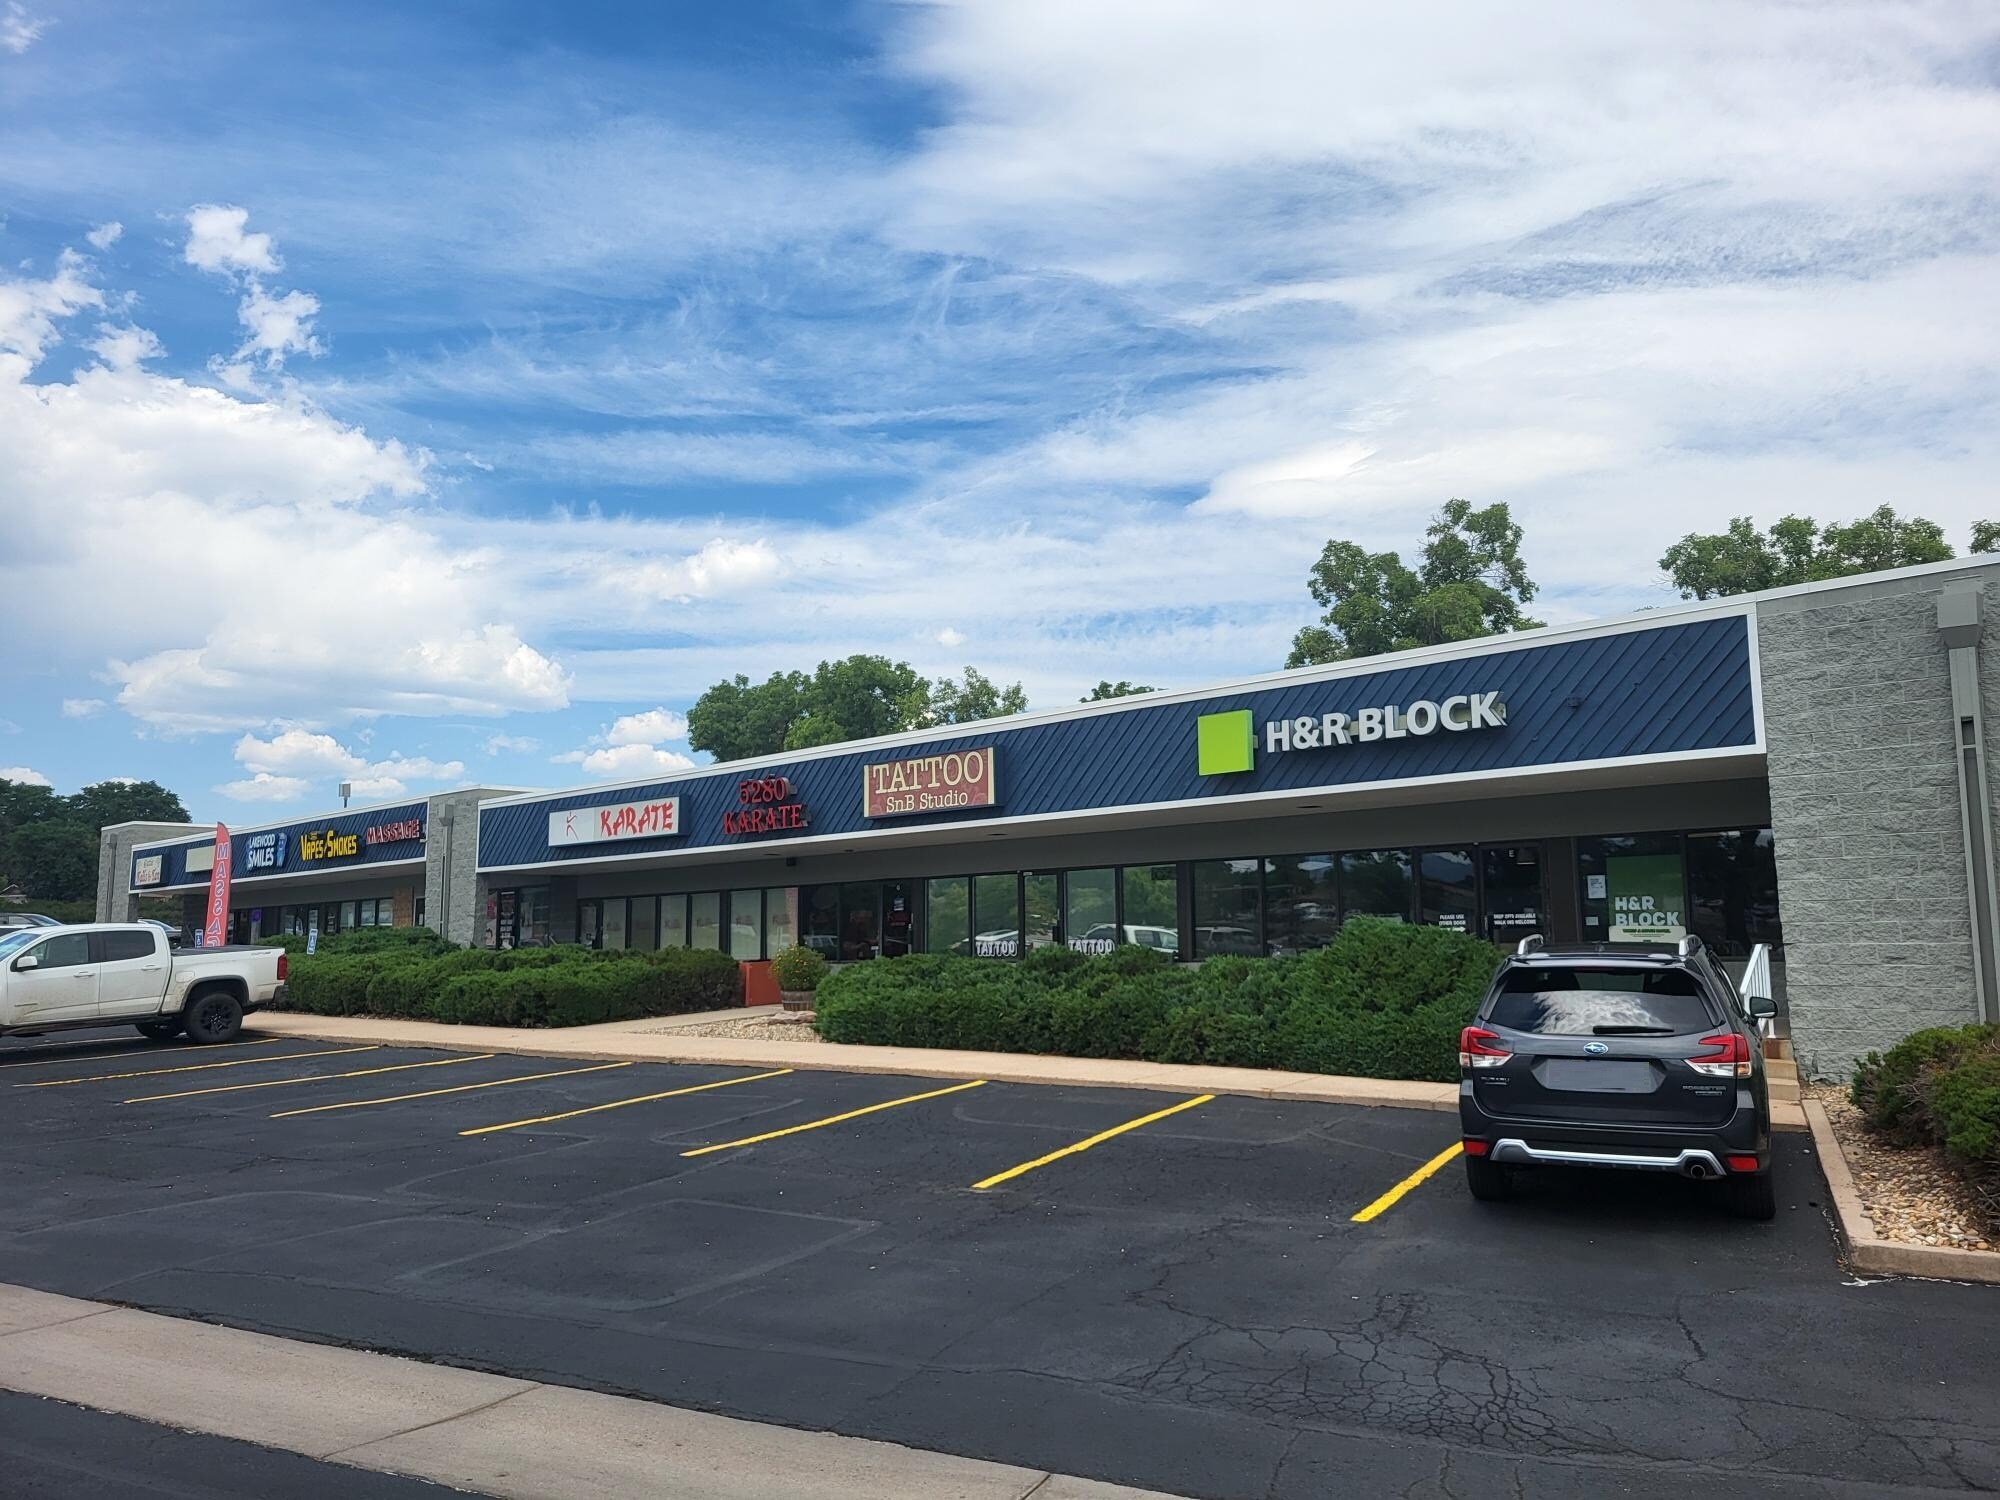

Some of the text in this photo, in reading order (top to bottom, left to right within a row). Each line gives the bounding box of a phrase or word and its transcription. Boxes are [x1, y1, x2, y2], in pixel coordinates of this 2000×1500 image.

[1266, 690, 1503, 753] H&R BLOCK
[873, 751, 984, 795] TATTOO
[738, 777, 786, 805] 5280
[886, 789, 969, 814] SnB Studio
[366, 818, 420, 845] MASSAGE
[600, 801, 674, 837] KARATE
[723, 804, 803, 835] KARATE
[249, 833, 276, 849] LAKEWOOD
[247, 847, 275, 869] SMILES
[1614, 895, 1656, 911] H&R
[1615, 911, 1681, 927] BLOCK
[975, 940, 1018, 957] TATTOO
[1067, 939, 1116, 958] TATTOO
